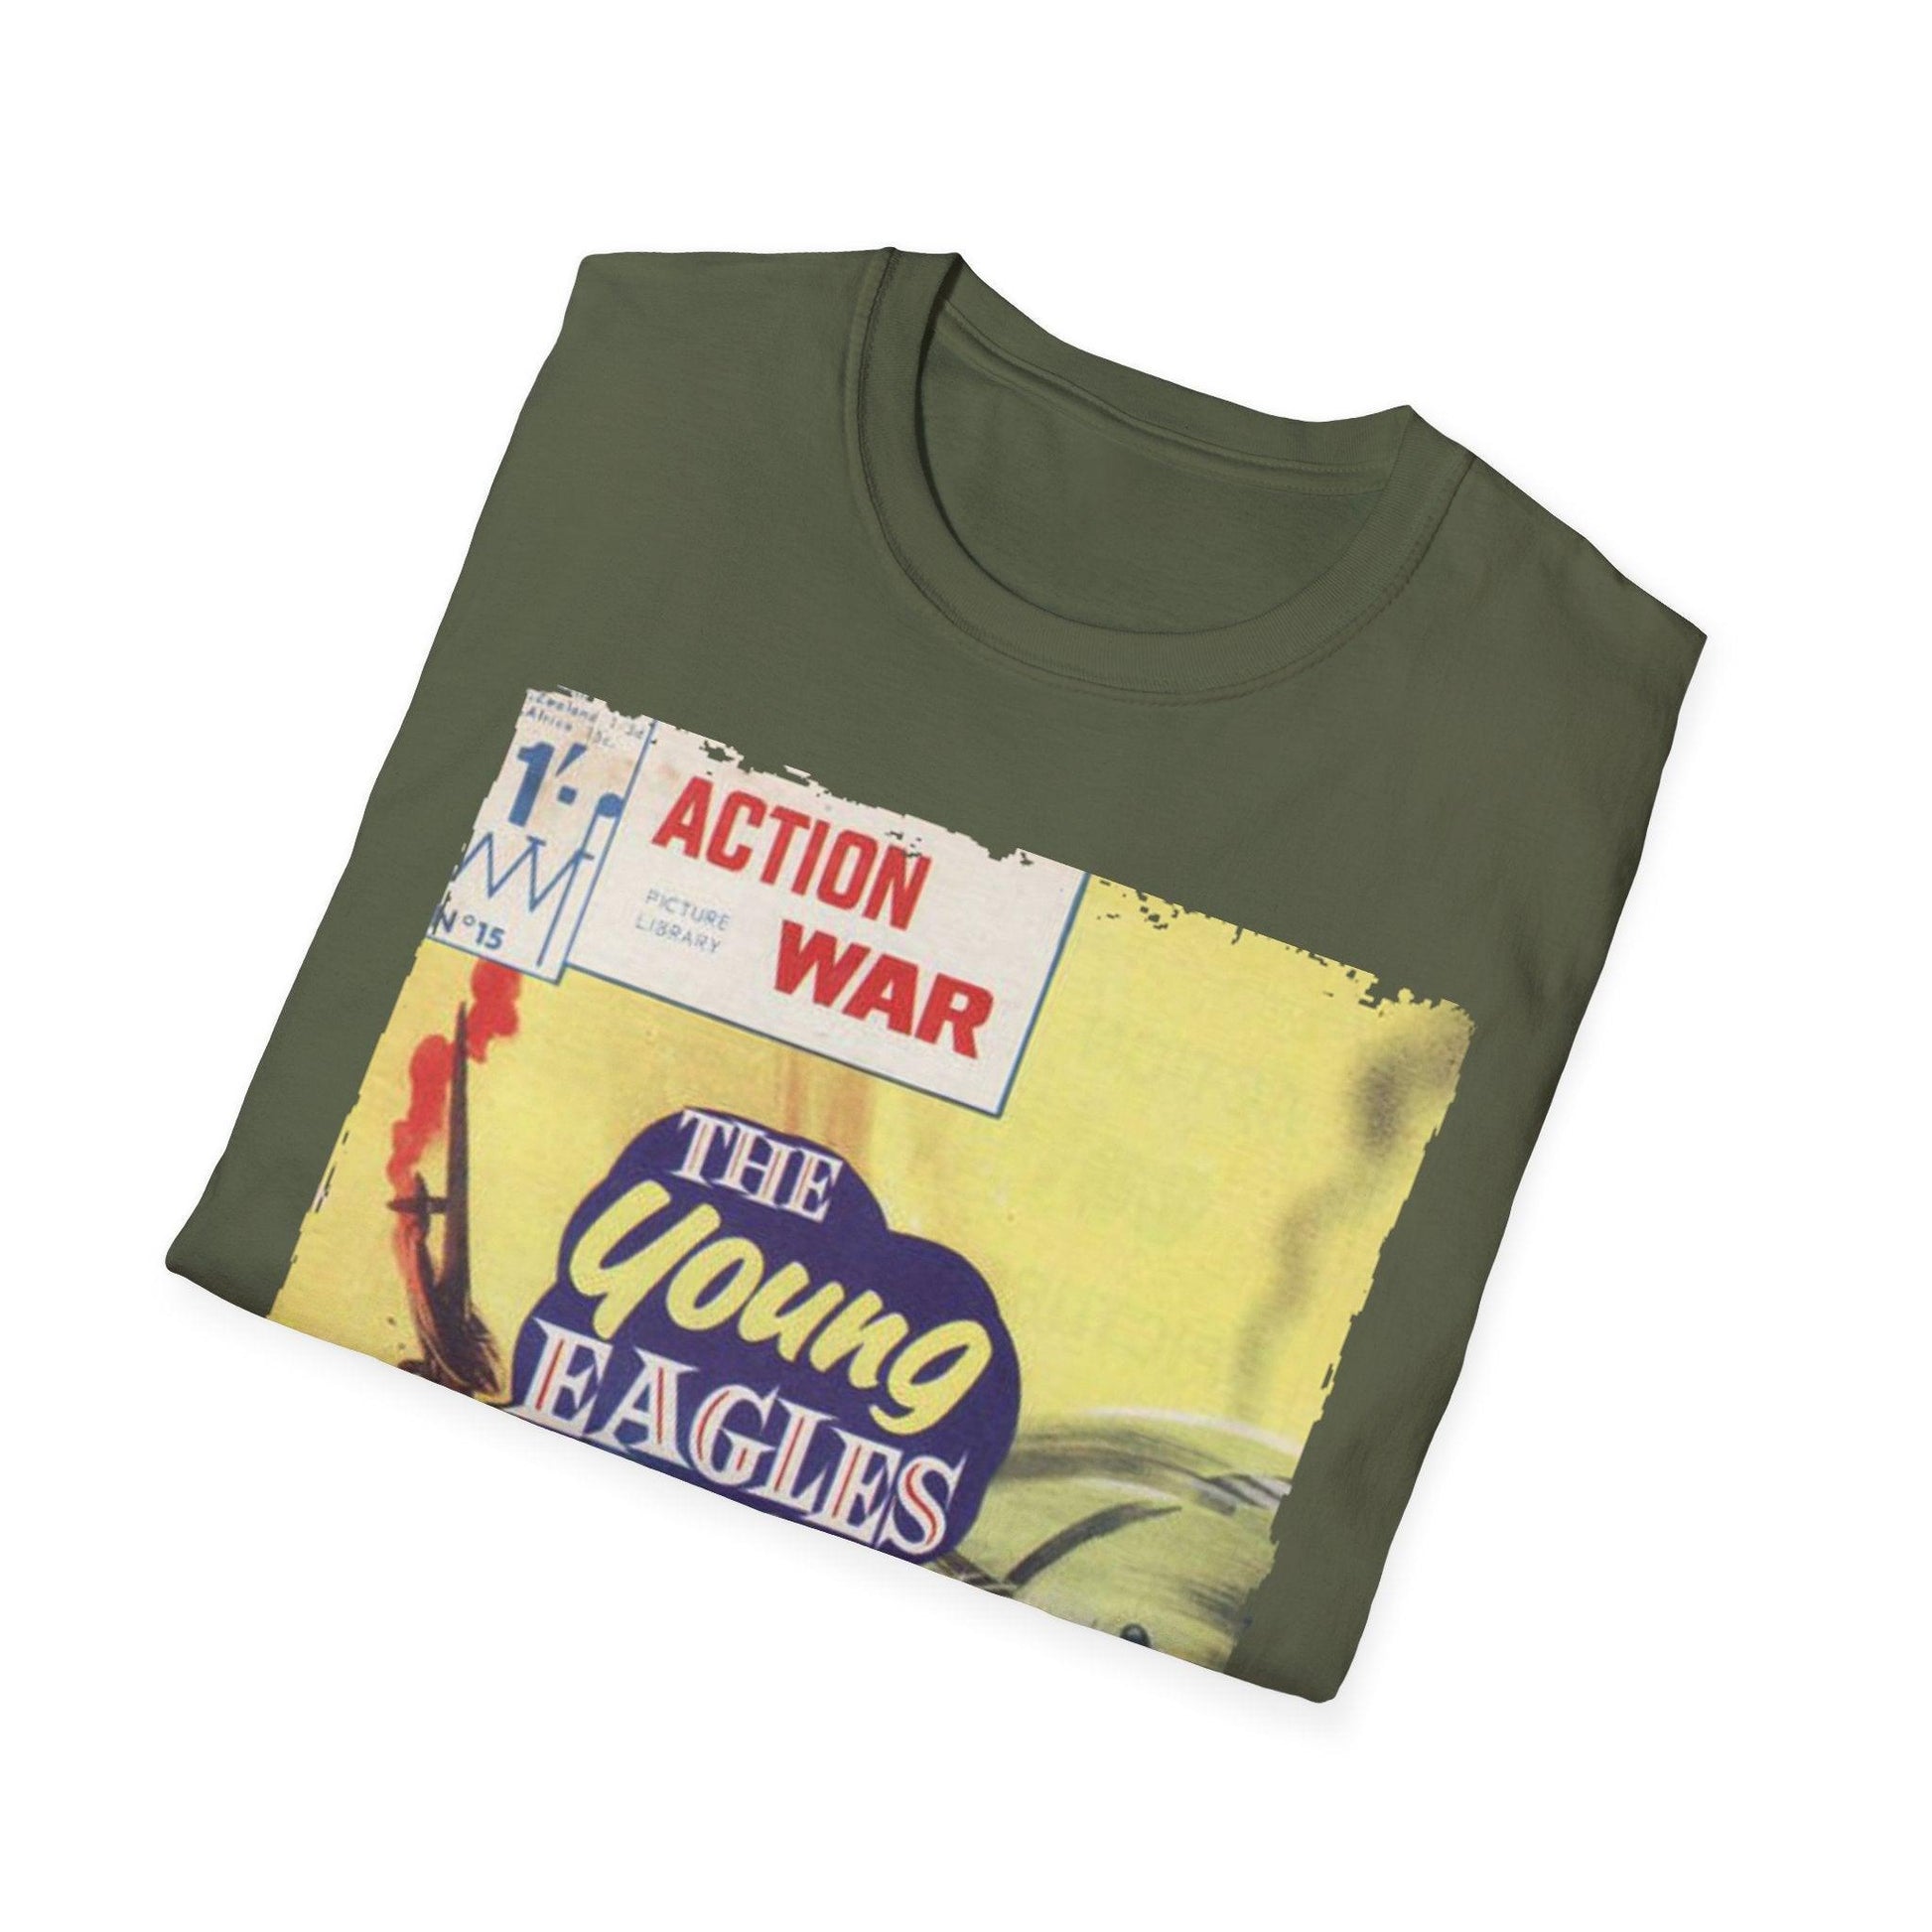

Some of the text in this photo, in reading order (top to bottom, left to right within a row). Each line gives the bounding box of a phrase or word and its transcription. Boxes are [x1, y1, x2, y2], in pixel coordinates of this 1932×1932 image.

[644, 888, 732, 931] PICTURE
[651, 775, 933, 931] ACTION
[634, 912, 722, 954] LIBRARY
[773, 919, 995, 1059] WAR
[669, 1108, 844, 1224] THE
[502, 1315, 968, 1557] EAGLES
